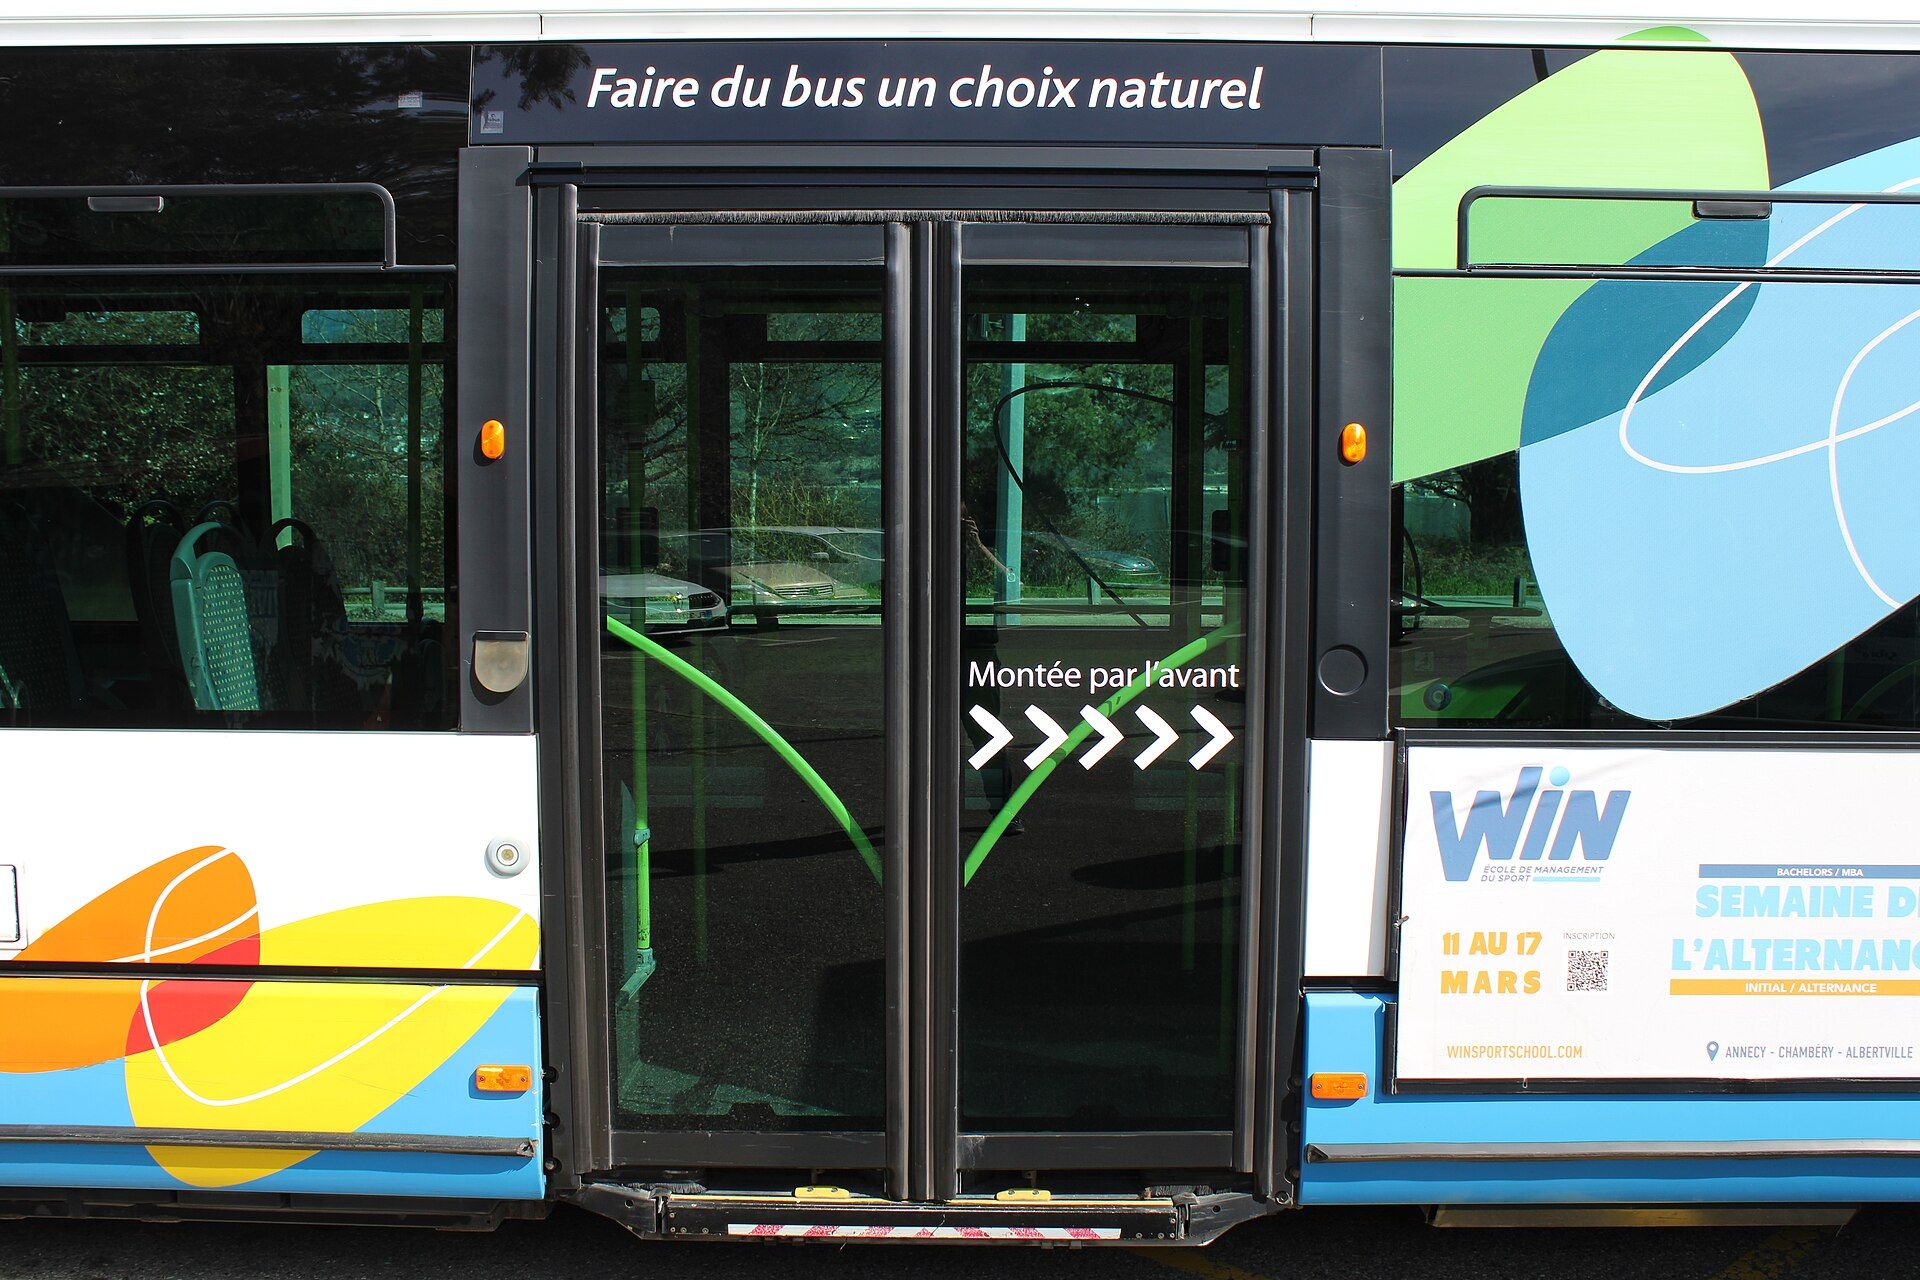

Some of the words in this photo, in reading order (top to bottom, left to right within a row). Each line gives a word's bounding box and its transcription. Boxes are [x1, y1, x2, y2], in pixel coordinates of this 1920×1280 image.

[587, 65, 700, 108] Faire
[710, 64, 772, 108] du
[781, 64, 866, 108] bus
[877, 77, 937, 108] un
[949, 64, 1081, 108] choix
[1088, 66, 1264, 110] naturel
[968, 660, 1082, 688] Montée
[1090, 667, 1138, 694] par
[1145, 660, 1240, 688] l'avant
[1483, 864, 1516, 874] ÉCOLE
[1518, 865, 1533, 874] DE
[1534, 865, 1605, 875] MANAGEMENT
[1777, 867, 1833, 877] BACHELORS
[1841, 868, 1864, 877] MBA
[1480, 874, 1496, 883] DU
[1497, 874, 1532, 883] SPORT
[1695, 884, 1875, 918] SEMAINE
[1887, 885, 1920, 918] D
[1442, 931, 1461, 956] 11
[1468, 931, 1508, 956] AU
[1516, 931, 1543, 956] 17
[1563, 932, 1616, 940] INSCRIPTION
[1671, 938, 1920, 971] L'ALTERNAN
[1440, 969, 1542, 995] MARS
[1745, 982, 1787, 993] INITIAL
[1798, 982, 1877, 993] ALTERNANCE
[1446, 1044, 1583, 1060] WINSPORTSCHOOL.COM
[1725, 1045, 1767, 1059] ANNECY
[1778, 1043, 1835, 1059] CHAMBÉRY
[1845, 1045, 1914, 1059] ALBERTVILLE
